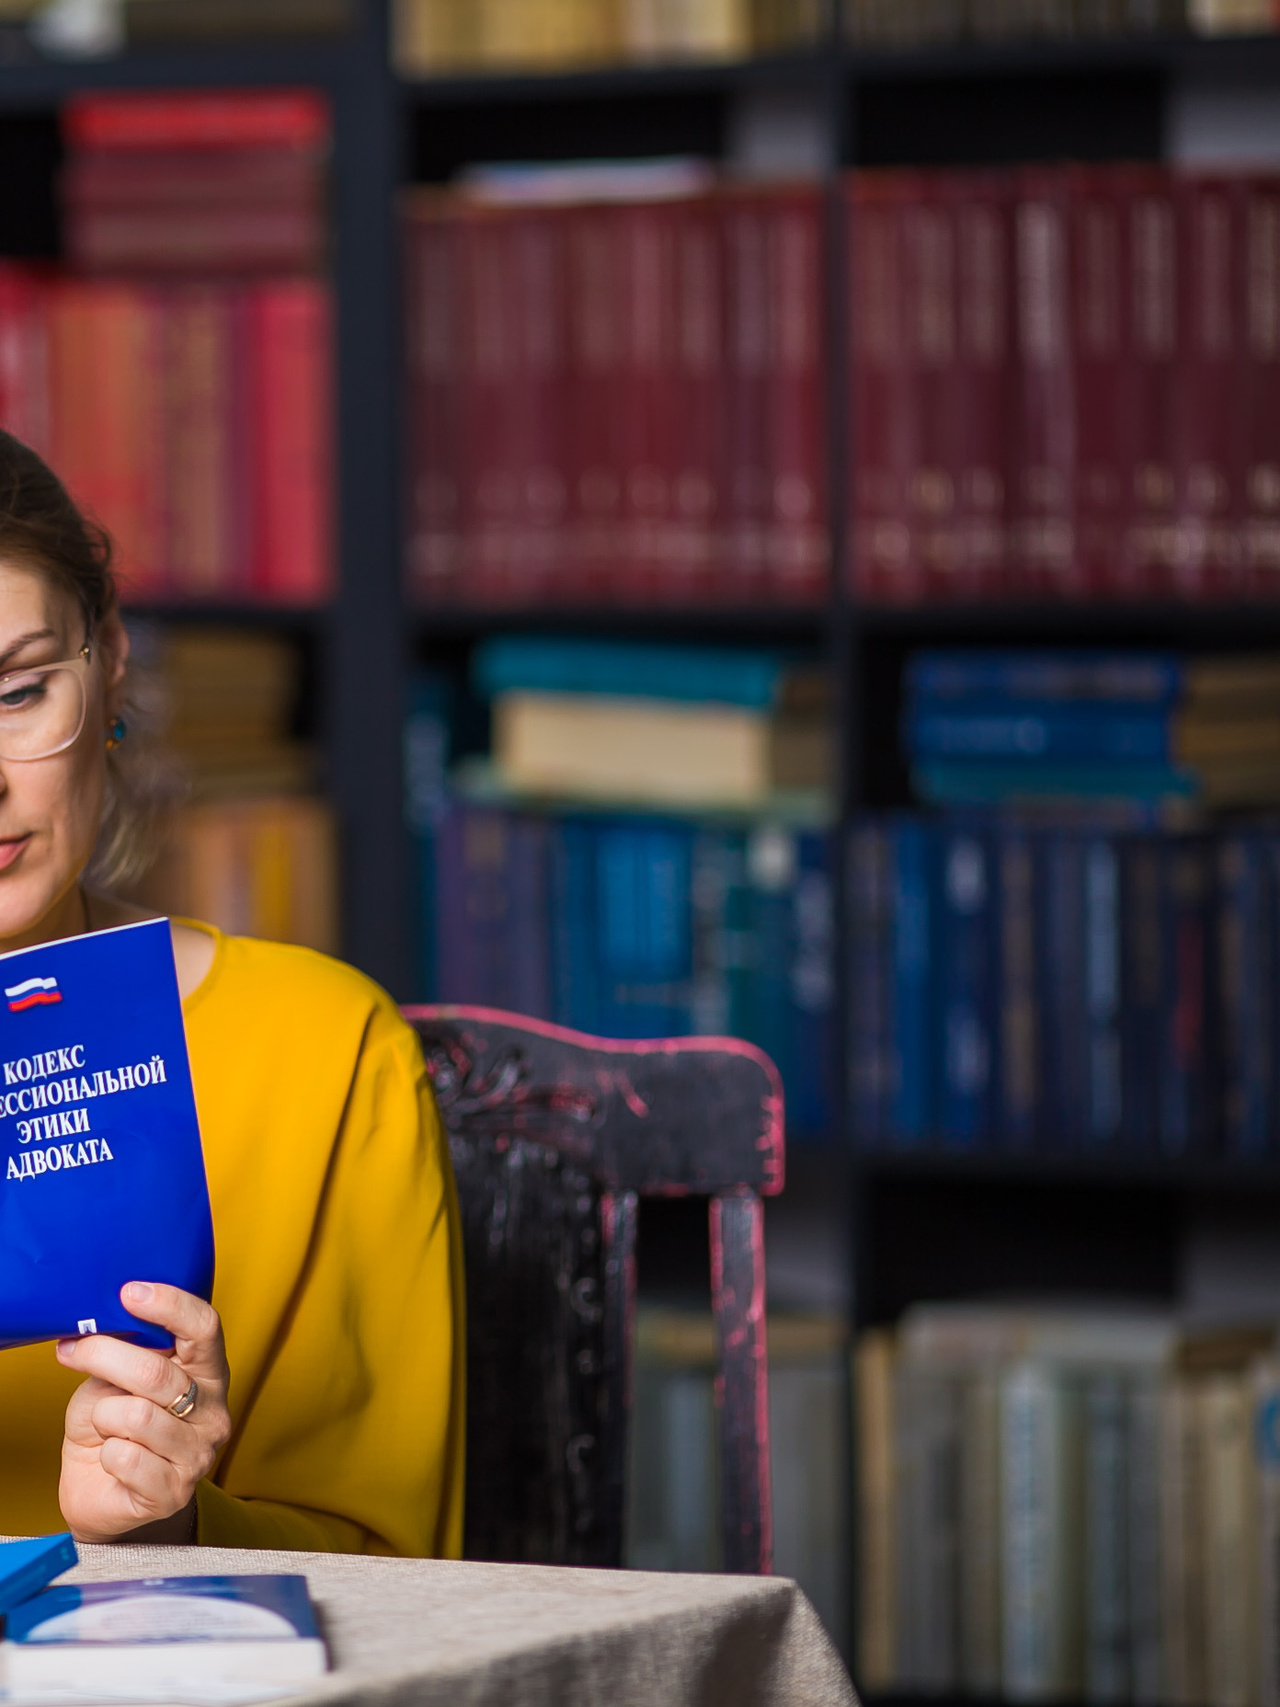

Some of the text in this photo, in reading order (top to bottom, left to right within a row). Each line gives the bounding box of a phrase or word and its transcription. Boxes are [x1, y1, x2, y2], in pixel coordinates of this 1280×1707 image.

[2, 1044, 86, 1086] КОДЕКС
[16, 1108, 91, 1144] ЭТИКИ
[6, 1138, 114, 1182] АДВОКАТА
